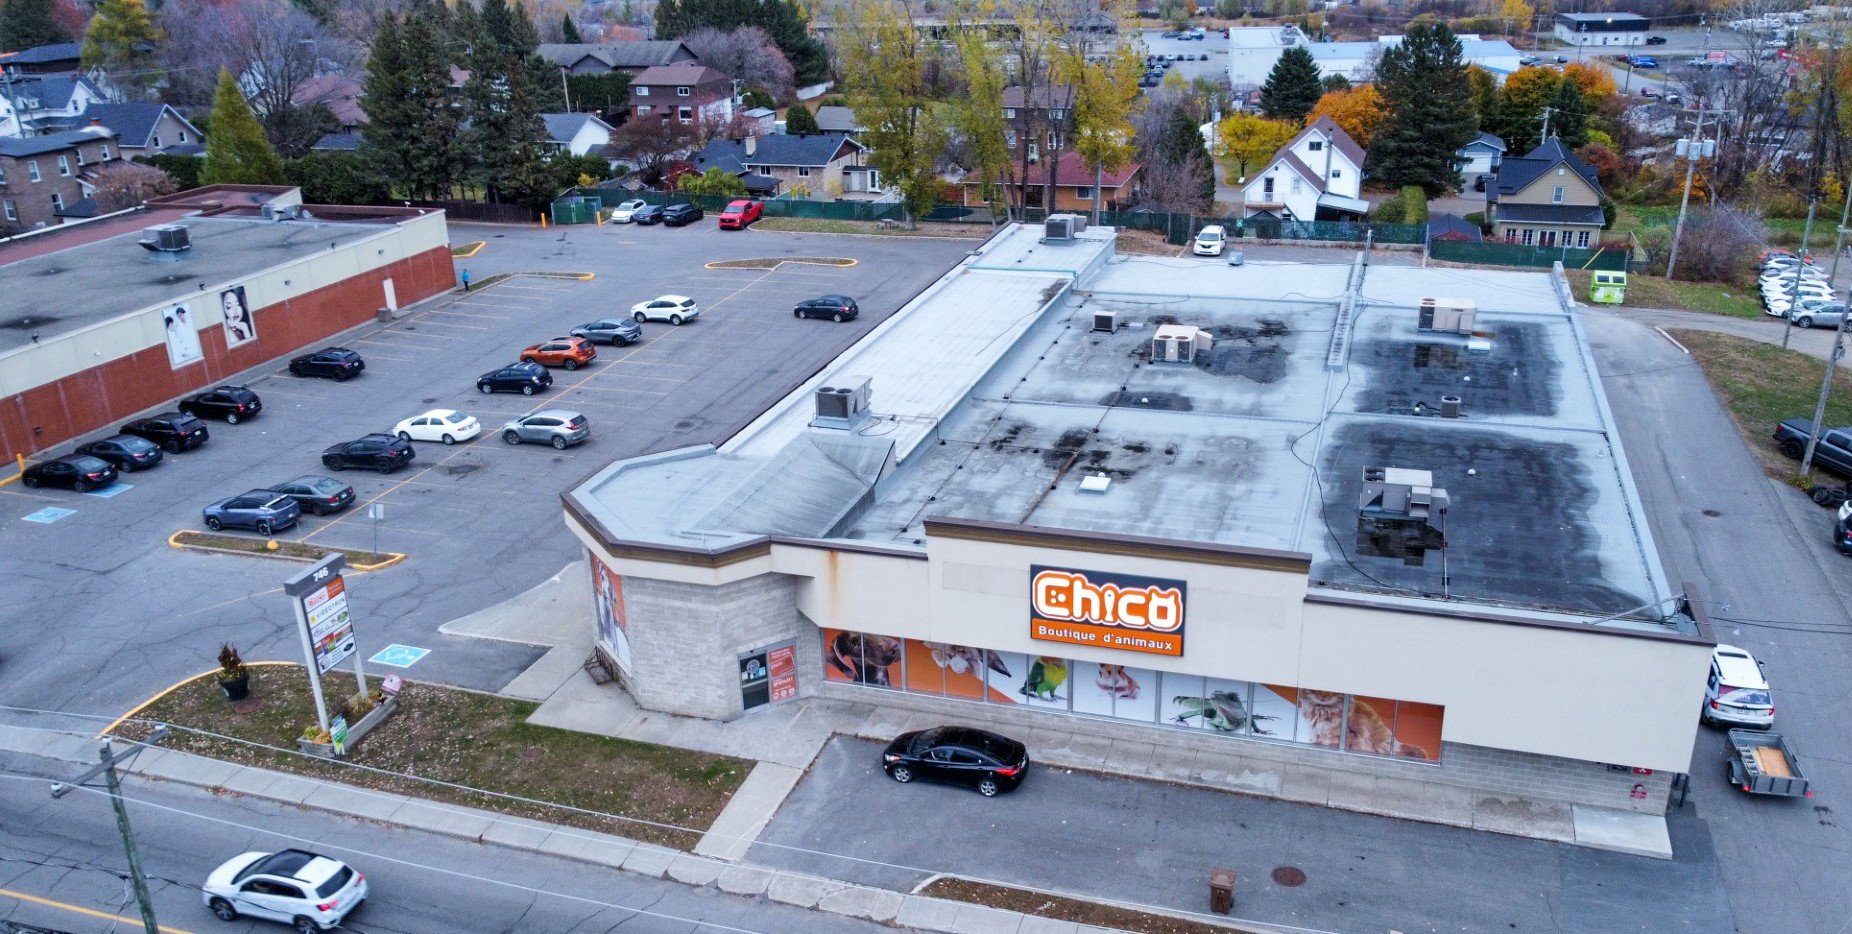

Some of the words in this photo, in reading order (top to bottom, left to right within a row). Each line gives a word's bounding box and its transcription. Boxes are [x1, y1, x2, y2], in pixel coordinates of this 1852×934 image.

[313, 567, 329, 582] 746
[1034, 572, 1182, 631] Chico
[1038, 626, 1096, 641] Boutique
[1103, 632, 1173, 651] d'animaux
